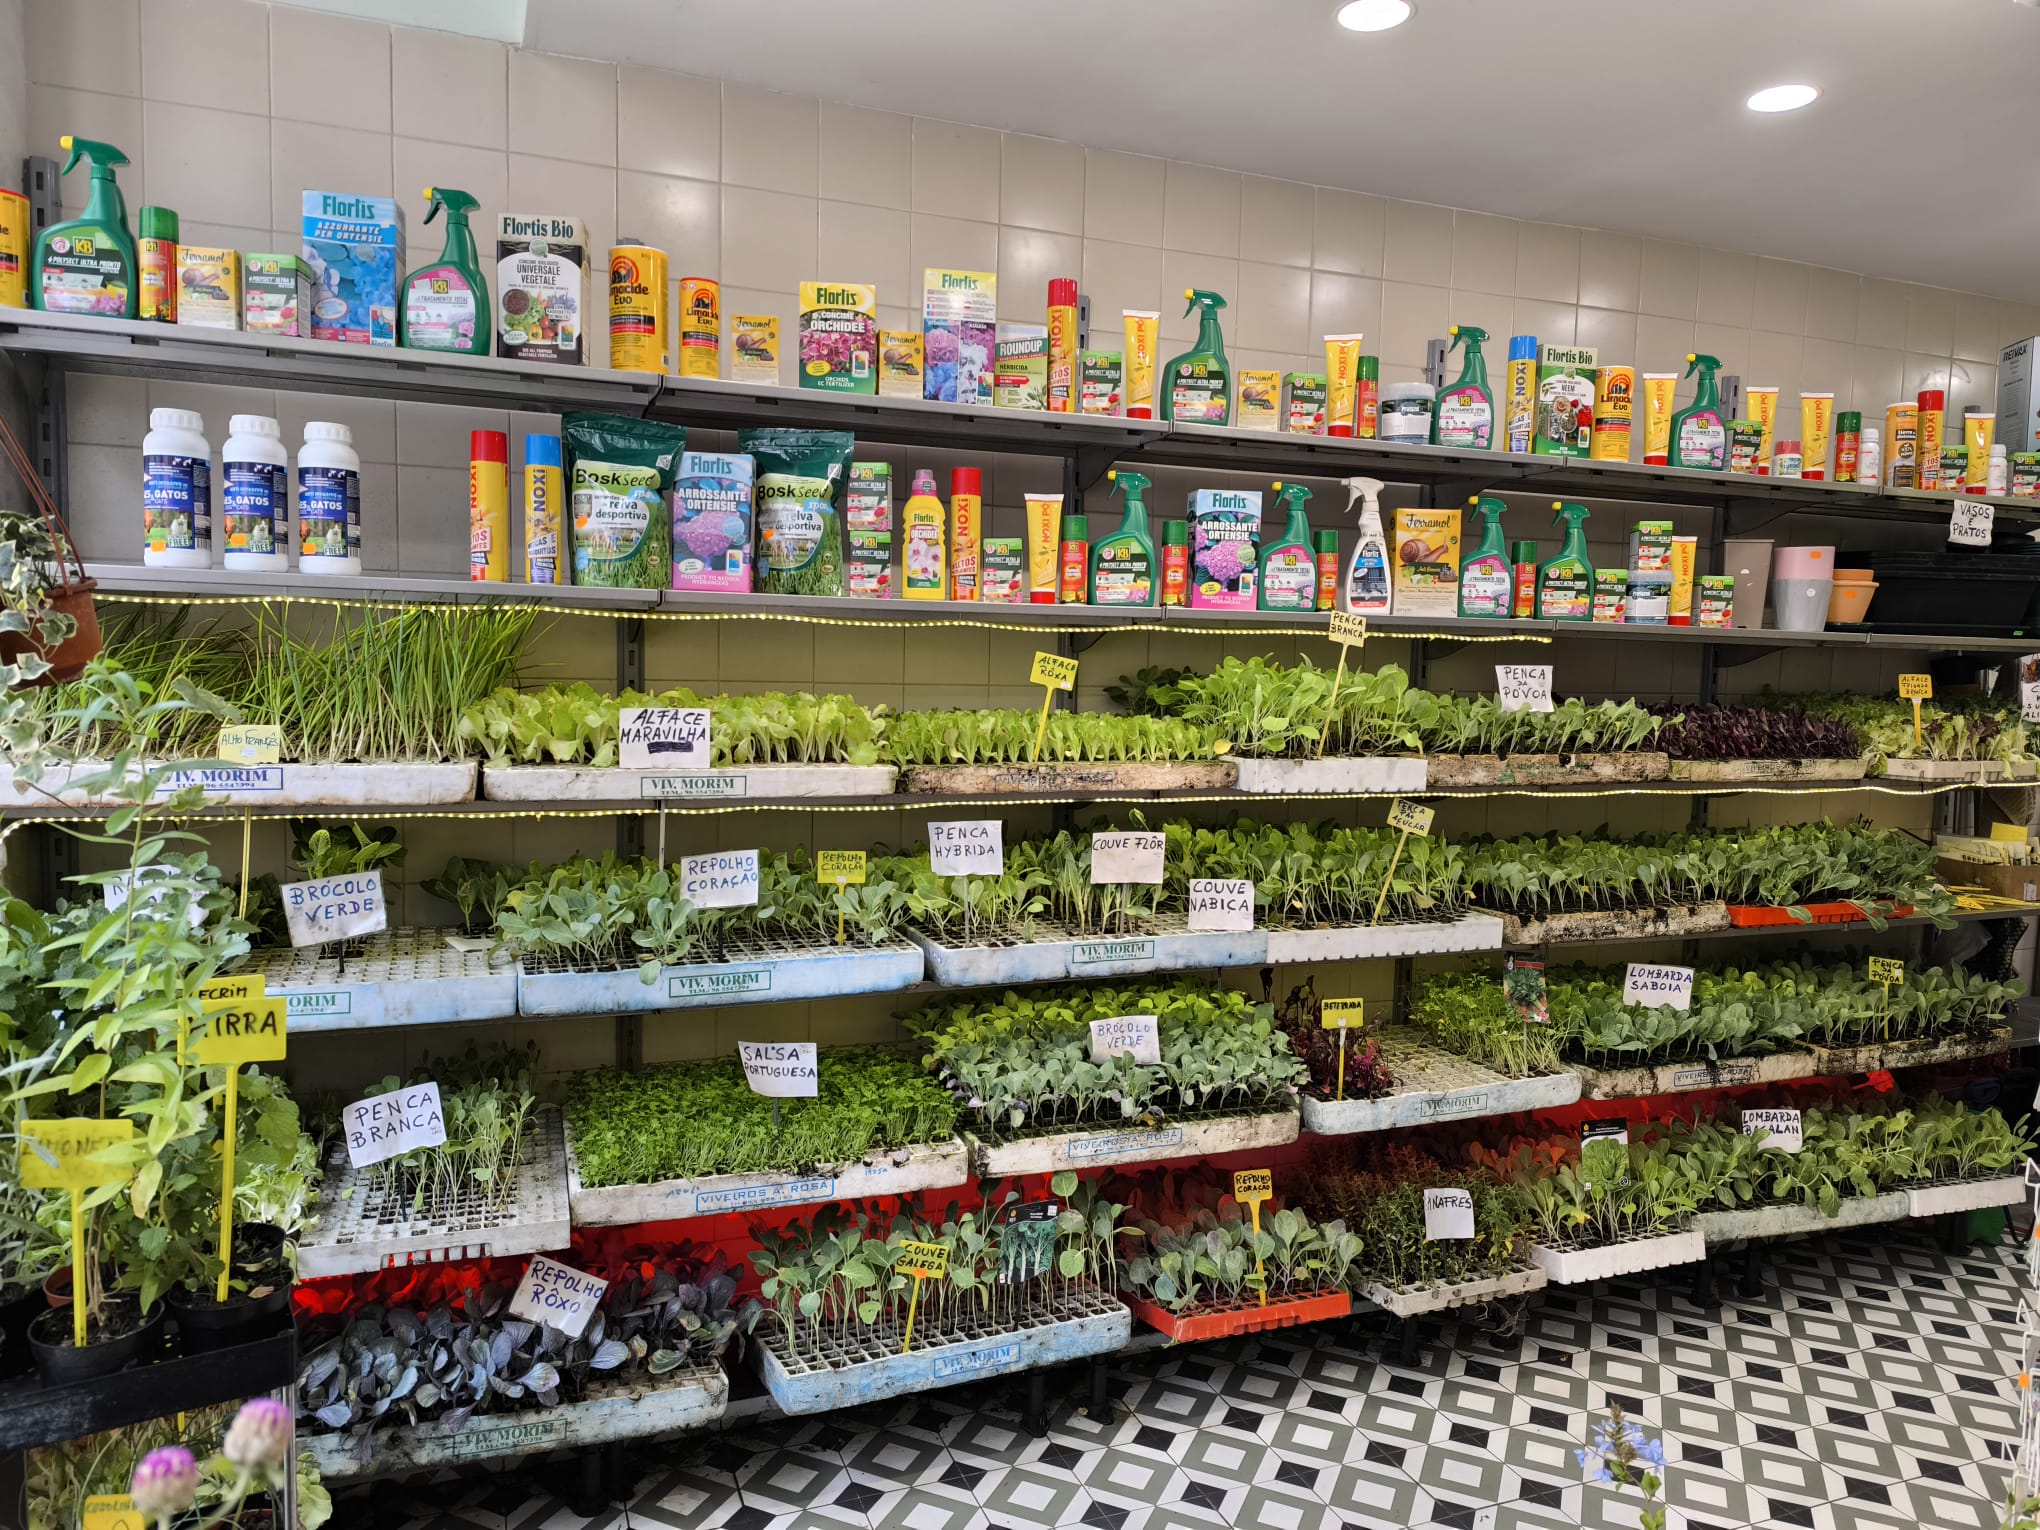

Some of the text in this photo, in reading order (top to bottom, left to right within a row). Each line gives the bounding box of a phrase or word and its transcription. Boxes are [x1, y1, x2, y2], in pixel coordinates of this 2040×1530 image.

[322, 195, 376, 220] Flortis
[316, 221, 381, 234] AZZURRANTE
[503, 217, 573, 239] Flortis Bio
[314, 230, 383, 244] PER ORTENSIE
[75, 239, 92, 254] KB
[146, 241, 158, 251] KB
[53, 256, 79, 265] POLYSECT
[80, 258, 98, 267] ULTRA
[181, 248, 226, 264] Ferramol
[264, 261, 278, 272] KB
[516, 264, 561, 277] UNIVERSALE
[432, 279, 449, 293] KB
[521, 274, 557, 286] VEGETALE
[941, 273, 979, 291] Flortis
[422, 295, 453, 304] TRATAMENTO
[614, 295, 633, 305] Evo
[816, 287, 857, 306] Flortis
[697, 316, 713, 326] Evo
[734, 316, 771, 329] Ferramol
[821, 311, 855, 321] CONCIME
[810, 320, 866, 334] ORCHIDEE
[882, 332, 918, 345] Ferramol
[999, 340, 1043, 356] ROUNDUP
[1547, 348, 1593, 365] Flortis Bio
[1194, 364, 1208, 376] KB
[1339, 358, 1347, 380] NOXI
[826, 381, 855, 389] FERTILIZER
[1241, 373, 1274, 383] Ferramol
[1561, 384, 1576, 392] NEEM
[1459, 395, 1472, 406] KB
[1613, 402, 1628, 411] Evo
[690, 455, 733, 475] Flortis
[862, 469, 873, 479] KB
[153, 489, 188, 500] GATOS
[236, 496, 269, 506] GATOS
[678, 487, 747, 501] ARROSSANTE
[1212, 492, 1247, 509] Flortis
[311, 501, 343, 511] GATOS
[687, 499, 737, 512] ORTENSIE
[1960, 503, 1990, 519] VASOS
[595, 509, 648, 521] desportiva
[914, 513, 934, 523] Flortis
[1406, 513, 1451, 529] Ferramol
[1042, 519, 1050, 544] NOXI
[1201, 520, 1258, 533] ARROSSANTE
[1952, 523, 1986, 538] PRATOS
[911, 529, 938, 539] ORCHIDEE
[1208, 530, 1249, 541] ORTENSIE
[169, 537, 189, 548] FREE
[250, 542, 270, 552] FREE
[865, 537, 876, 547] KB
[324, 546, 343, 556] FREE
[1117, 547, 1129, 559] KB
[1362, 550, 1378, 558] Flortis
[1285, 555, 1296, 566] KB
[1481, 565, 1493, 575] KB
[1561, 567, 1573, 578] KB
[1333, 612, 1363, 627] PENCA
[1330, 624, 1363, 639] BRANCA
[1038, 655, 1076, 670] ALFACE
[1040, 666, 1068, 682] RÔXA
[1503, 666, 1546, 680] PENCA
[1502, 685, 1547, 700] PÓVOA
[633, 708, 705, 726] ALFACE
[621, 727, 706, 744] MARAVILHA
[201, 769, 268, 782] MORIM
[651, 778, 735, 790] VIV. MORIM
[1398, 799, 1425, 815] PENCA
[934, 826, 990, 841] PENCA
[934, 843, 995, 859] HYBRIDA
[1092, 837, 1129, 852] COUVE
[688, 856, 755, 876] REPOLHO
[687, 868, 758, 893] CORAÇÃO
[1192, 879, 1246, 895] COUVE
[289, 877, 377, 905] BRÓCOLO
[305, 897, 375, 923] VERDE
[1190, 897, 1250, 915] NABIÇA
[1080, 941, 1146, 956] VIV. MORIM
[1871, 957, 1904, 970] PENCA
[680, 972, 760, 989] VIV. MORIM
[1629, 966, 1693, 983] LOMBARDA
[1871, 971, 1901, 984] PÓVOA
[1631, 980, 1682, 993] SABOIA
[288, 994, 337, 1008] ORIM
[1097, 1021, 1151, 1037] BRÓCOLO
[1107, 1034, 1144, 1049] VERDE
[744, 1045, 800, 1062] SALSA
[744, 1062, 816, 1079] PORTUGUESA
[354, 1091, 433, 1127] PENCA
[1742, 1111, 1800, 1125] LOMBARDA
[350, 1110, 441, 1149] BRANCA
[1072, 1130, 1179, 1151] VIVEIROS ROSA
[700, 1185, 766, 1205] VIVEIROS
[772, 1187, 786, 1197] A.
[791, 1181, 829, 1193] ROSA
[904, 1243, 946, 1259] COUVE
[895, 1257, 945, 1272] GALEGA
[531, 1260, 604, 1299] REPOLHO
[531, 1283, 582, 1314] RÔXO
[943, 1346, 1011, 1369] VIV. MORIM
[463, 1422, 556, 1447] VIV. MORIM
